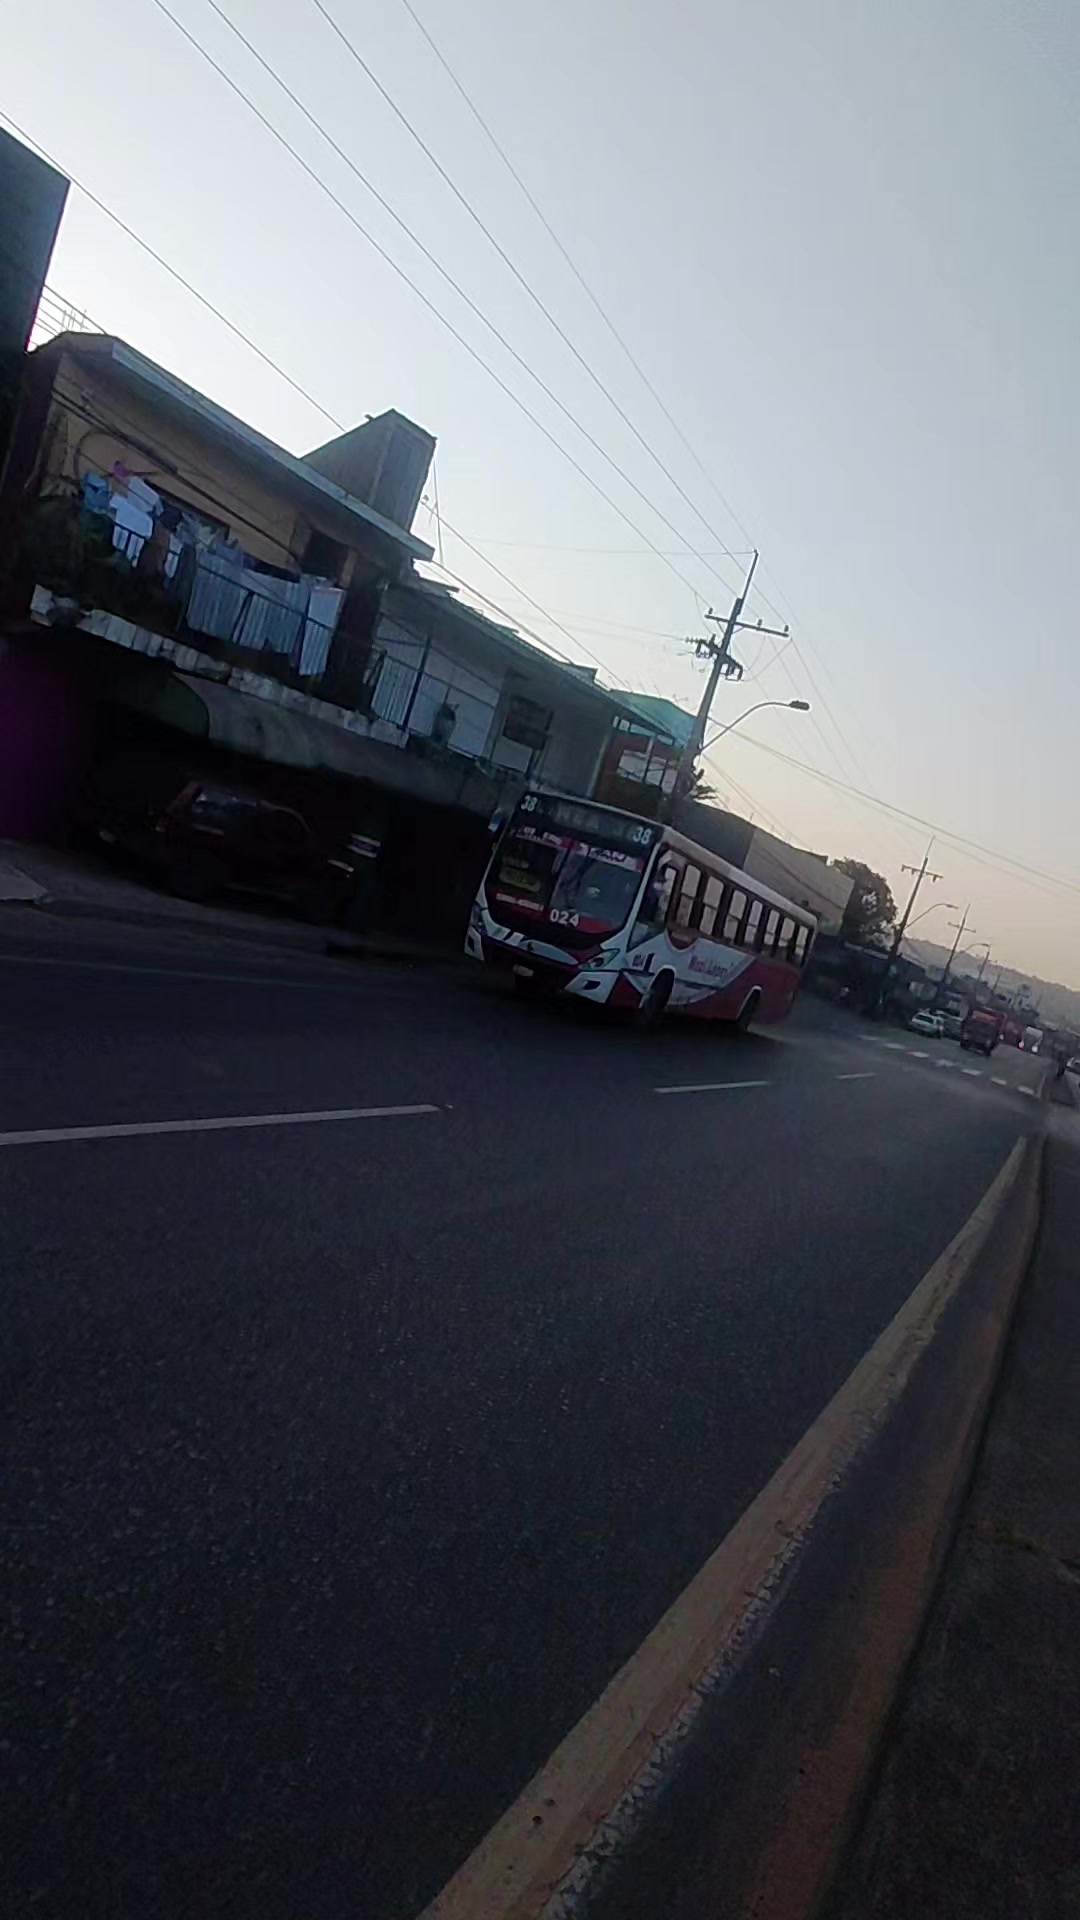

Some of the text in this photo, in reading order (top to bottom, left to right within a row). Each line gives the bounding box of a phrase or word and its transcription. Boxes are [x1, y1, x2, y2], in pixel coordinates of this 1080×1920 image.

[520, 794, 538, 812] 38
[632, 826, 652, 845] 38
[549, 908, 580, 928] 024
